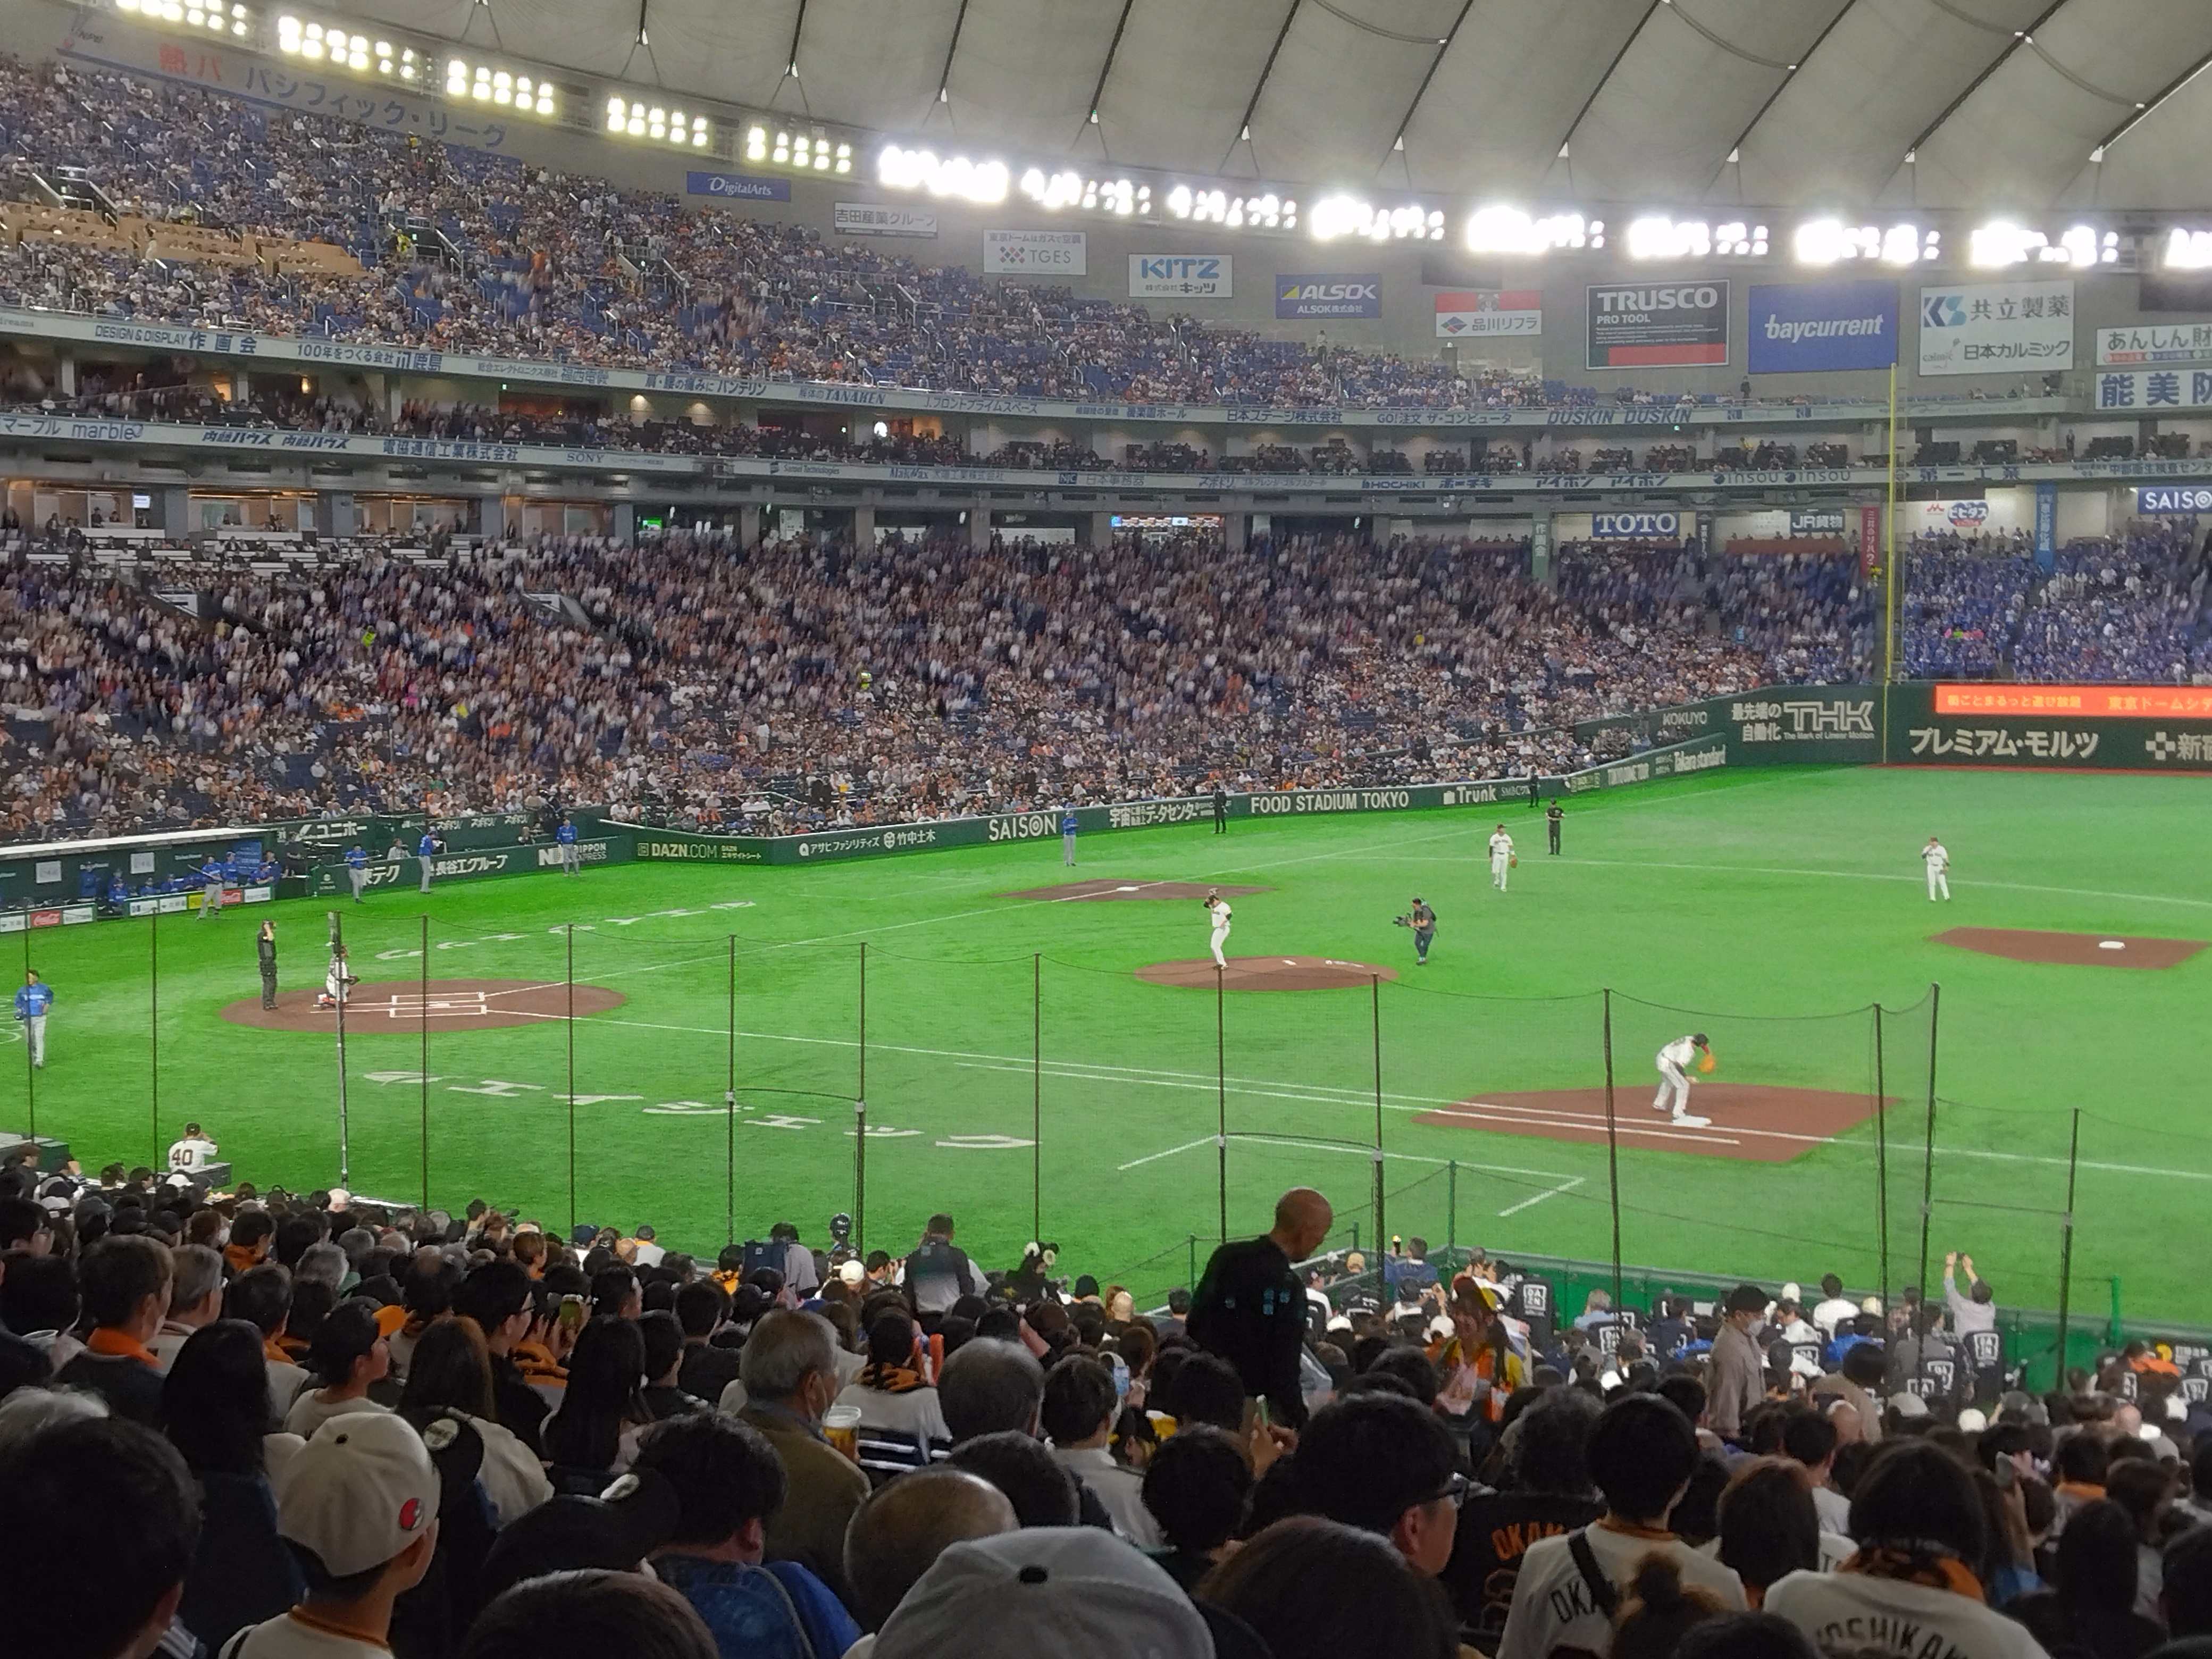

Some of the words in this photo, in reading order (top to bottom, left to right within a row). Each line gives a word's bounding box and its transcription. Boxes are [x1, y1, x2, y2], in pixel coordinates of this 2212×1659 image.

[246, 66, 506, 147] パシフィック・リーグ
[708, 177, 772, 195] DigitalArts
[835, 209, 934, 227] 吉田産業グループ
[1029, 249, 1071, 263] TGES
[1142, 258, 1220, 279] KITZ
[1301, 284, 1377, 300] ALSOK
[1597, 287, 1717, 312] TRUSCO
[1297, 305, 1363, 314] ALSOK株式会社
[1971, 295, 2070, 321] 共立製薬
[1472, 317, 1537, 331] 品川リフラ
[1597, 315, 1619, 324] PRO
[1622, 314, 1650, 323] TOOL
[1765, 314, 1883, 339] baycurrent
[95, 325, 133, 340] DESIGN
[135, 331, 143, 341] &
[144, 331, 187, 346] DISPLAY
[188, 331, 257, 354] 作画会
[297, 343, 393, 365] 100年をつくる会社
[1964, 340, 2070, 360] 日本カルミック
[717, 380, 767, 396] バンテリン
[1227, 410, 1342, 424] 日本ステージ株式会社
[1548, 410, 1613, 424] DUSKIN
[1624, 409, 1691, 424] DUSKIN
[72, 421, 133, 440] marble
[567, 453, 605, 464] SONY
[1371, 481, 1426, 489] HOCHIKI
[1596, 513, 1677, 533] TOTO
[1792, 515, 1843, 528] JR貨物
[1663, 711, 1708, 726] KOKUYO
[1732, 702, 1781, 720] 最先端の
[1783, 701, 1874, 731] THK
[1742, 722, 1781, 742] 自動化
[1909, 727, 2099, 758] プレミアム・モルツ
[1251, 797, 1291, 814] FOOD
[1296, 793, 1356, 812] STADIUM
[1363, 791, 1409, 809] TOKYO
[1456, 785, 1497, 804] Trunk
[1145, 802, 1197, 825] データセンター
[988, 814, 1057, 841] SAISON
[652, 843, 718, 858] DAZN.COM
[810, 836, 880, 854] アサヒファシリティズ
[898, 829, 936, 846] 竹中土木
[436, 854, 508, 876] 長谷工グループ
[171, 1148, 194, 1166] 40
